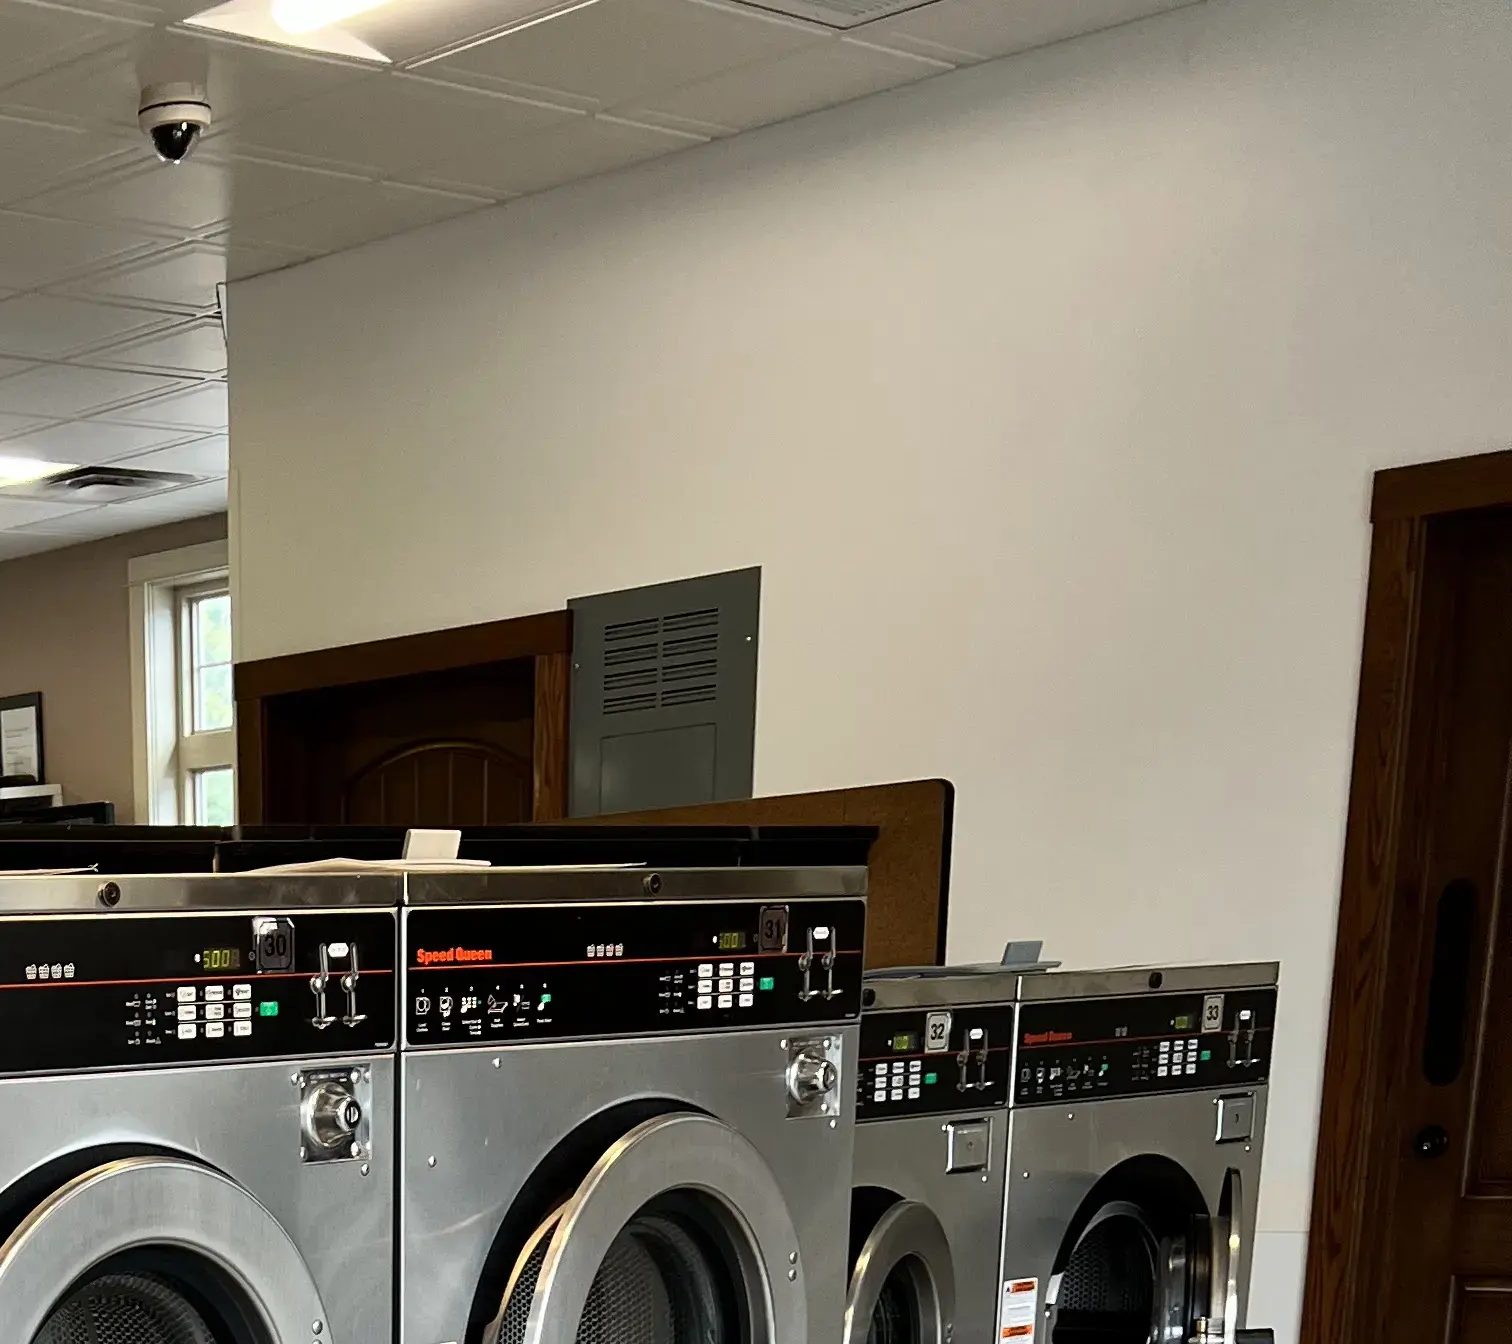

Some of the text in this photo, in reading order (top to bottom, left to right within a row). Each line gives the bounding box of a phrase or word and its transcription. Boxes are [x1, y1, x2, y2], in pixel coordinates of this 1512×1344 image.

[764, 918, 782, 939] 31
[263, 933, 287, 958] 30
[416, 946, 493, 965] Speed Queen
[1206, 1005, 1220, 1021] 33
[930, 1023, 945, 1040] 32
